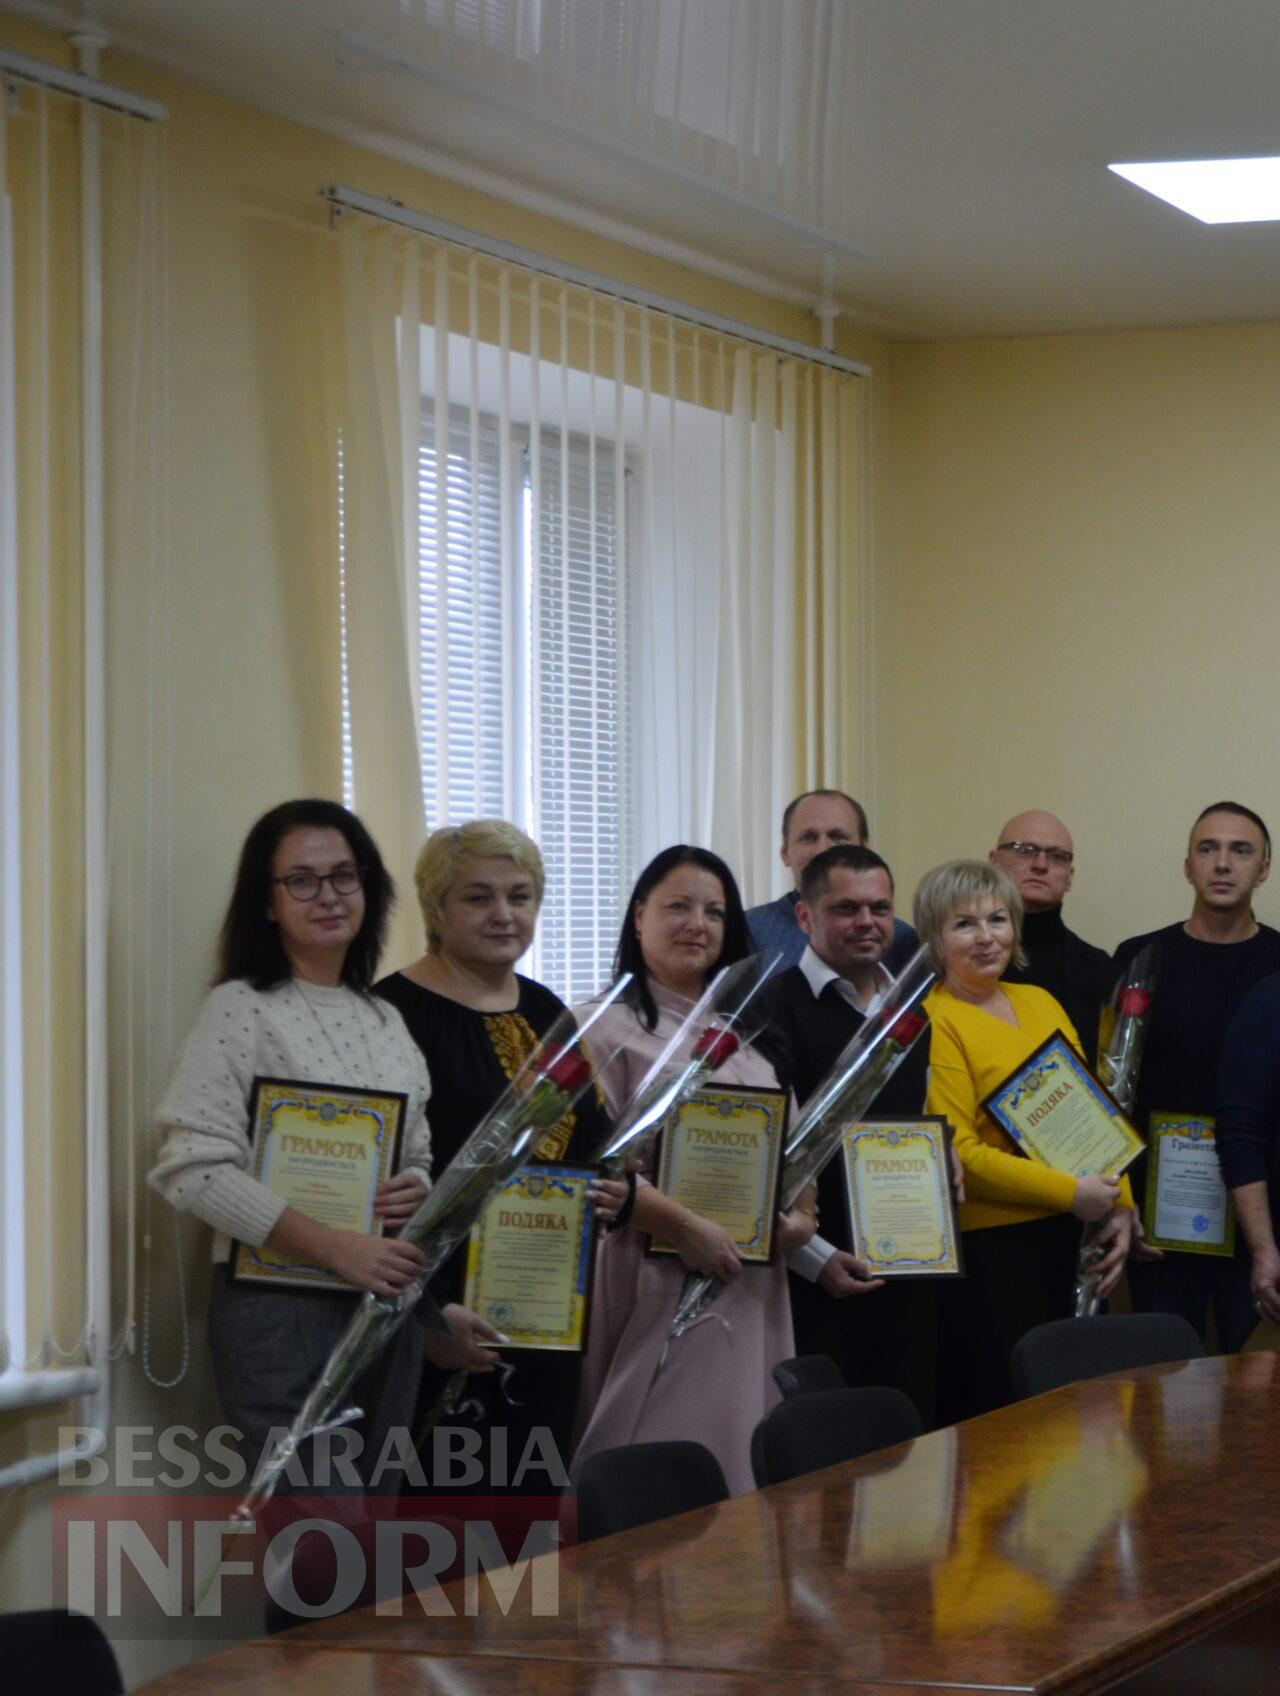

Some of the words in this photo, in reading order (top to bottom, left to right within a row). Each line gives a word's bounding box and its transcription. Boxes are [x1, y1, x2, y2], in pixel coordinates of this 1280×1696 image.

[1027, 1081, 1074, 1127] ПОДЯКА
[281, 1135, 367, 1160] ГРАМОТА
[687, 1128, 758, 1148] ГРАМОТА
[866, 1159, 929, 1173] ГРАМОТА
[498, 1211, 568, 1230] ПОДЯКА
